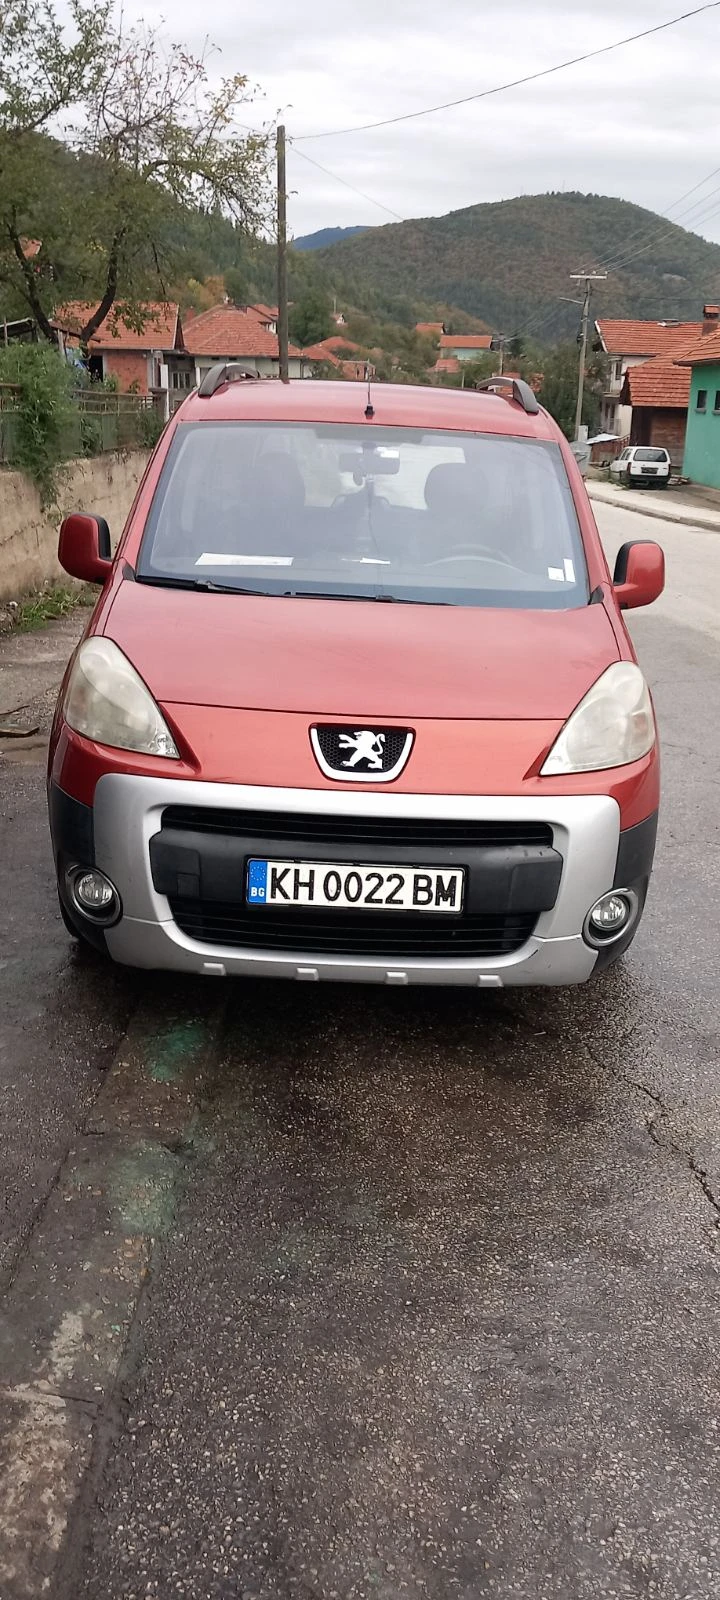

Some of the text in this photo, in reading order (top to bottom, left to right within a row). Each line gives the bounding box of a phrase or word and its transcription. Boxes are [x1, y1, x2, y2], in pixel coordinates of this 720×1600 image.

[250, 887, 265, 897] BG
[270, 867, 457, 907] KH 0022 BM
